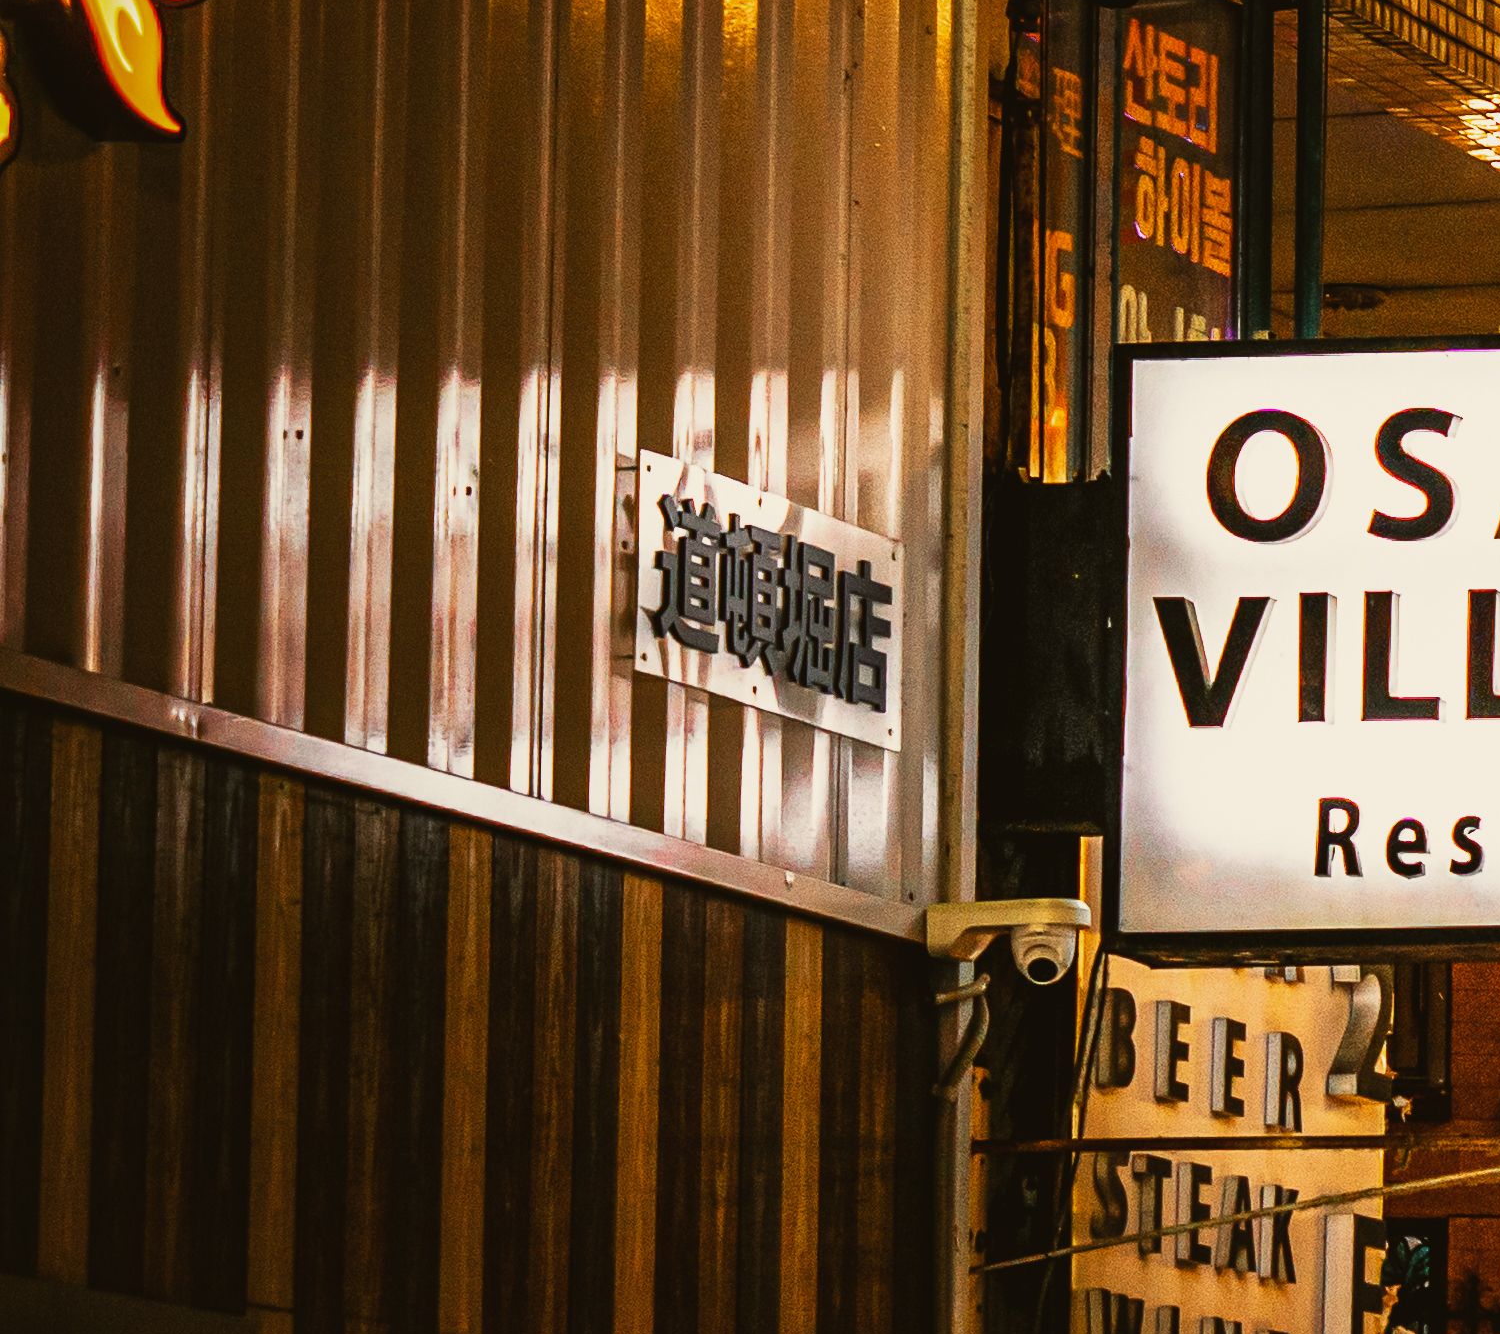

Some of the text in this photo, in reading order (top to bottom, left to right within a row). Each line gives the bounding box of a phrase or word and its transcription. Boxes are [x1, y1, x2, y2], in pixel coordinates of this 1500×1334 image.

[1122, 17, 1220, 156] 산토리
[1132, 135, 1234, 279] 하이볼
[652, 492, 894, 714] 道頓堀店
[1099, 987, 1304, 1134] BEER
[1090, 1150, 1300, 1285] STEAK
